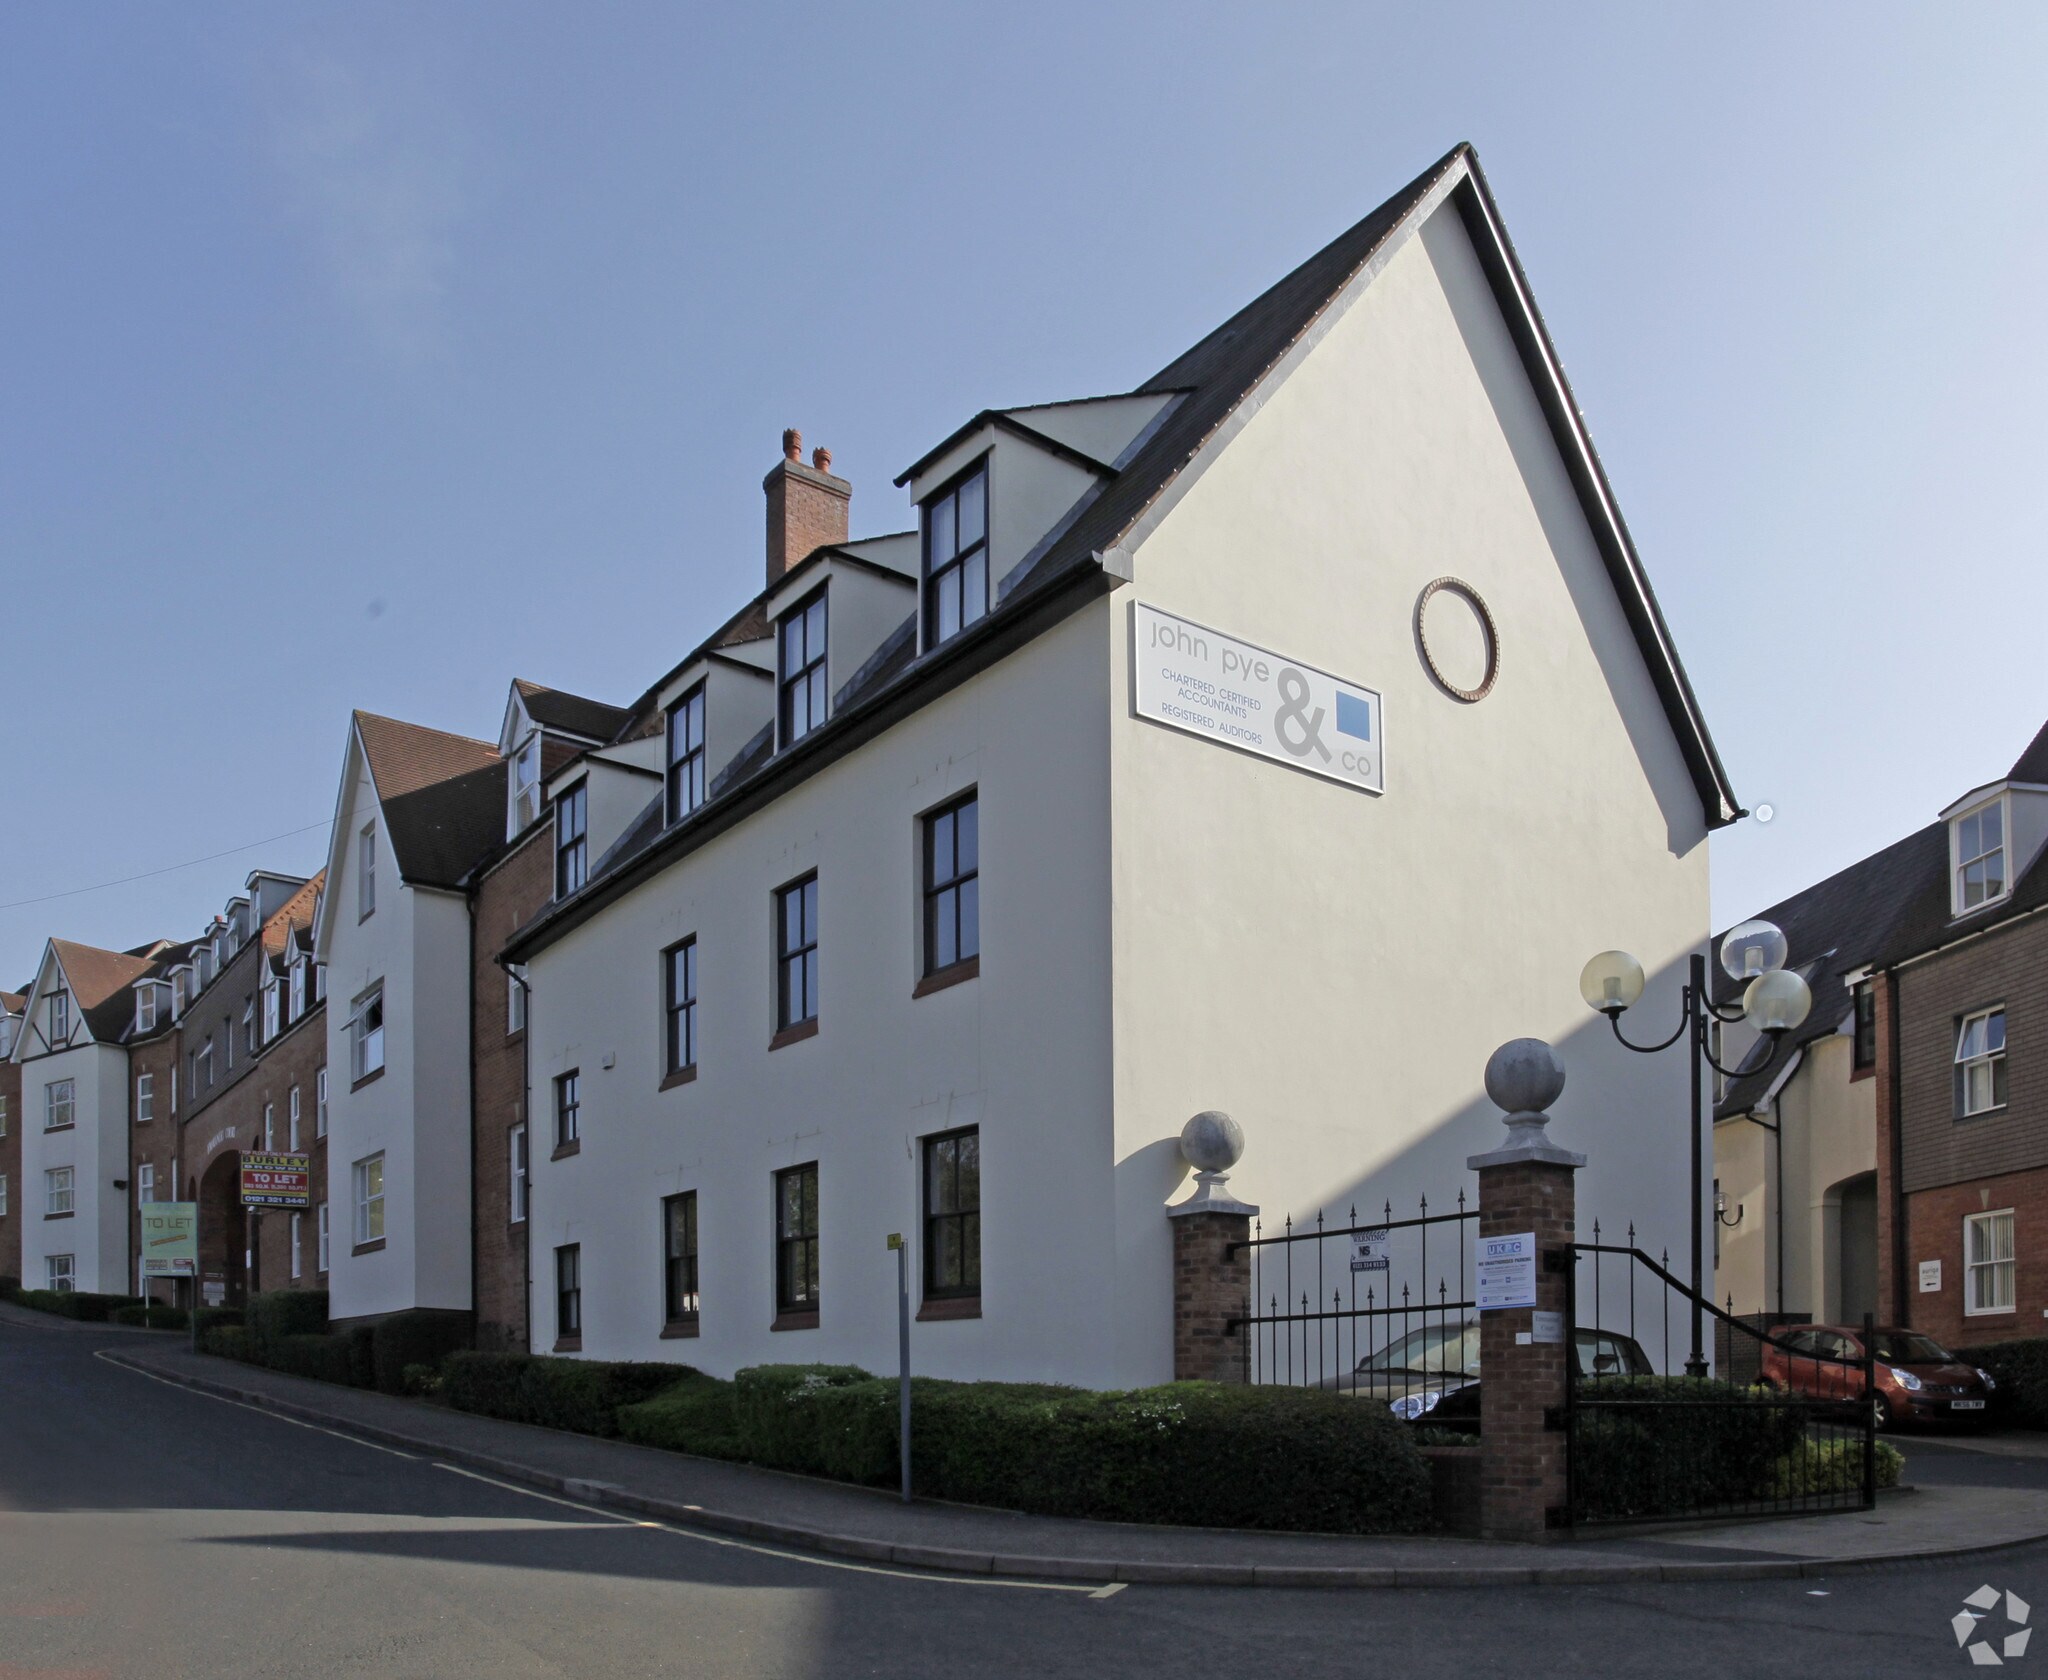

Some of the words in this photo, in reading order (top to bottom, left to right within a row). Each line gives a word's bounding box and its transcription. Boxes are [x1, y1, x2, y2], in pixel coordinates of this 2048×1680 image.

[1161, 668, 1215, 695] CHARTERED
[1219, 688, 1262, 711] CERTIFIED
[1177, 687, 1247, 719] ACCOUNTANTS
[1222, 647, 1270, 682] pye
[1274, 667, 1332, 764] &
[1161, 702, 1215, 729] REGISTERED
[1219, 722, 1263, 745] AUDITORS
[243, 1156, 307, 1165] BURLEY
[252, 1173, 270, 1182] TO
[274, 1174, 298, 1184] LET
[145, 1217, 163, 1229] TO
[168, 1217, 193, 1229] LET
[1353, 1234, 1385, 1243] WARNING
[1488, 1242, 1521, 1255] UKPC
